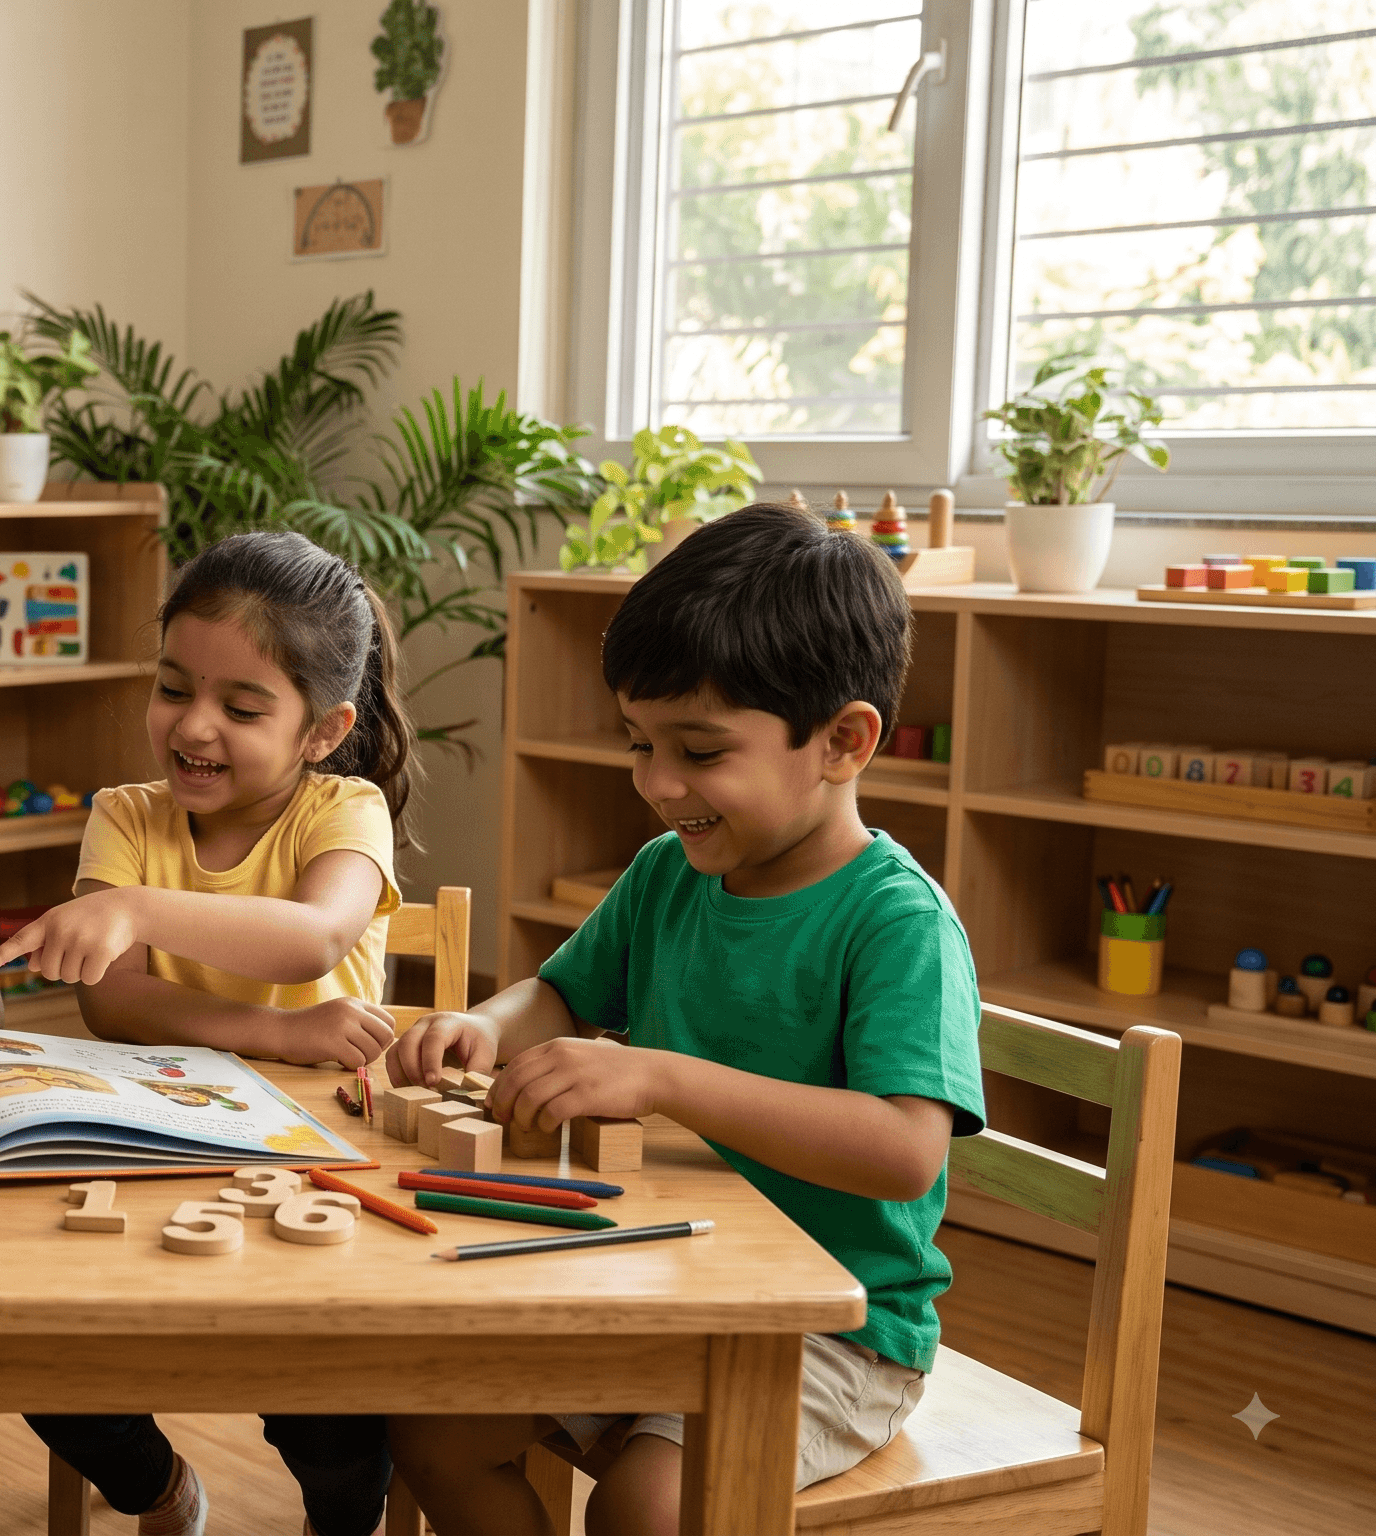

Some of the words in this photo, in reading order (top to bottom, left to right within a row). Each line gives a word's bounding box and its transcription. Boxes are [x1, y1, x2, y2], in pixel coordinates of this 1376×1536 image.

[1186, 759, 1205, 782] 8
[1299, 770, 1316, 793] 3
[1332, 776, 1354, 797] 4
[65, 1181, 126, 1232] 1
[162, 1200, 244, 1255] 5
[218, 1167, 302, 1217] 3
[274, 1190, 361, 1244] 6
